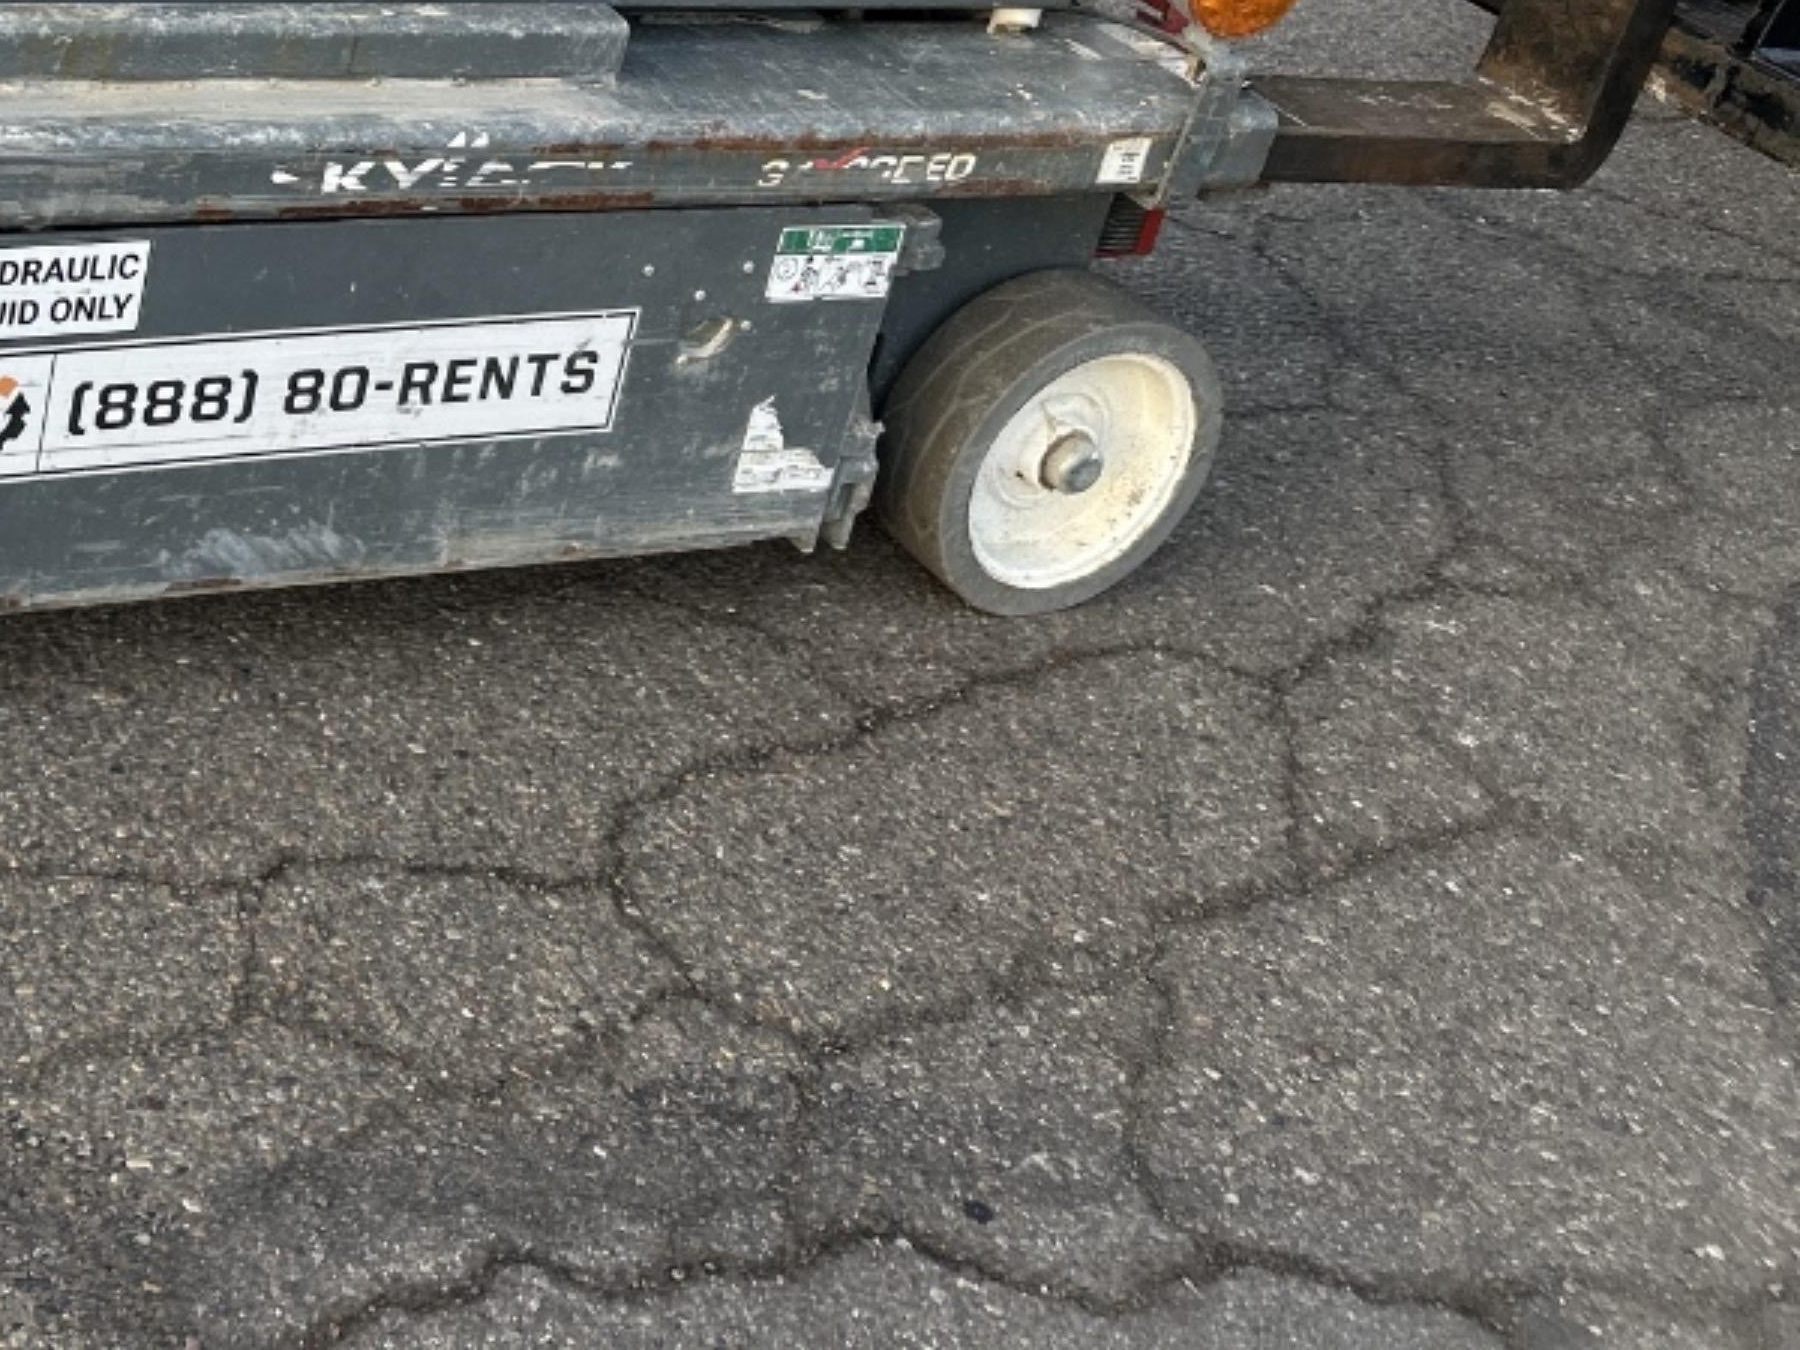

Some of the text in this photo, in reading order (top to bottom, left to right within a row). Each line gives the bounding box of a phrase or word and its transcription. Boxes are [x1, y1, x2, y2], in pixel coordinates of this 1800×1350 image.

[50, 294, 134, 324] ONLY
[67, 350, 600, 435] (888) 80-RENTS
